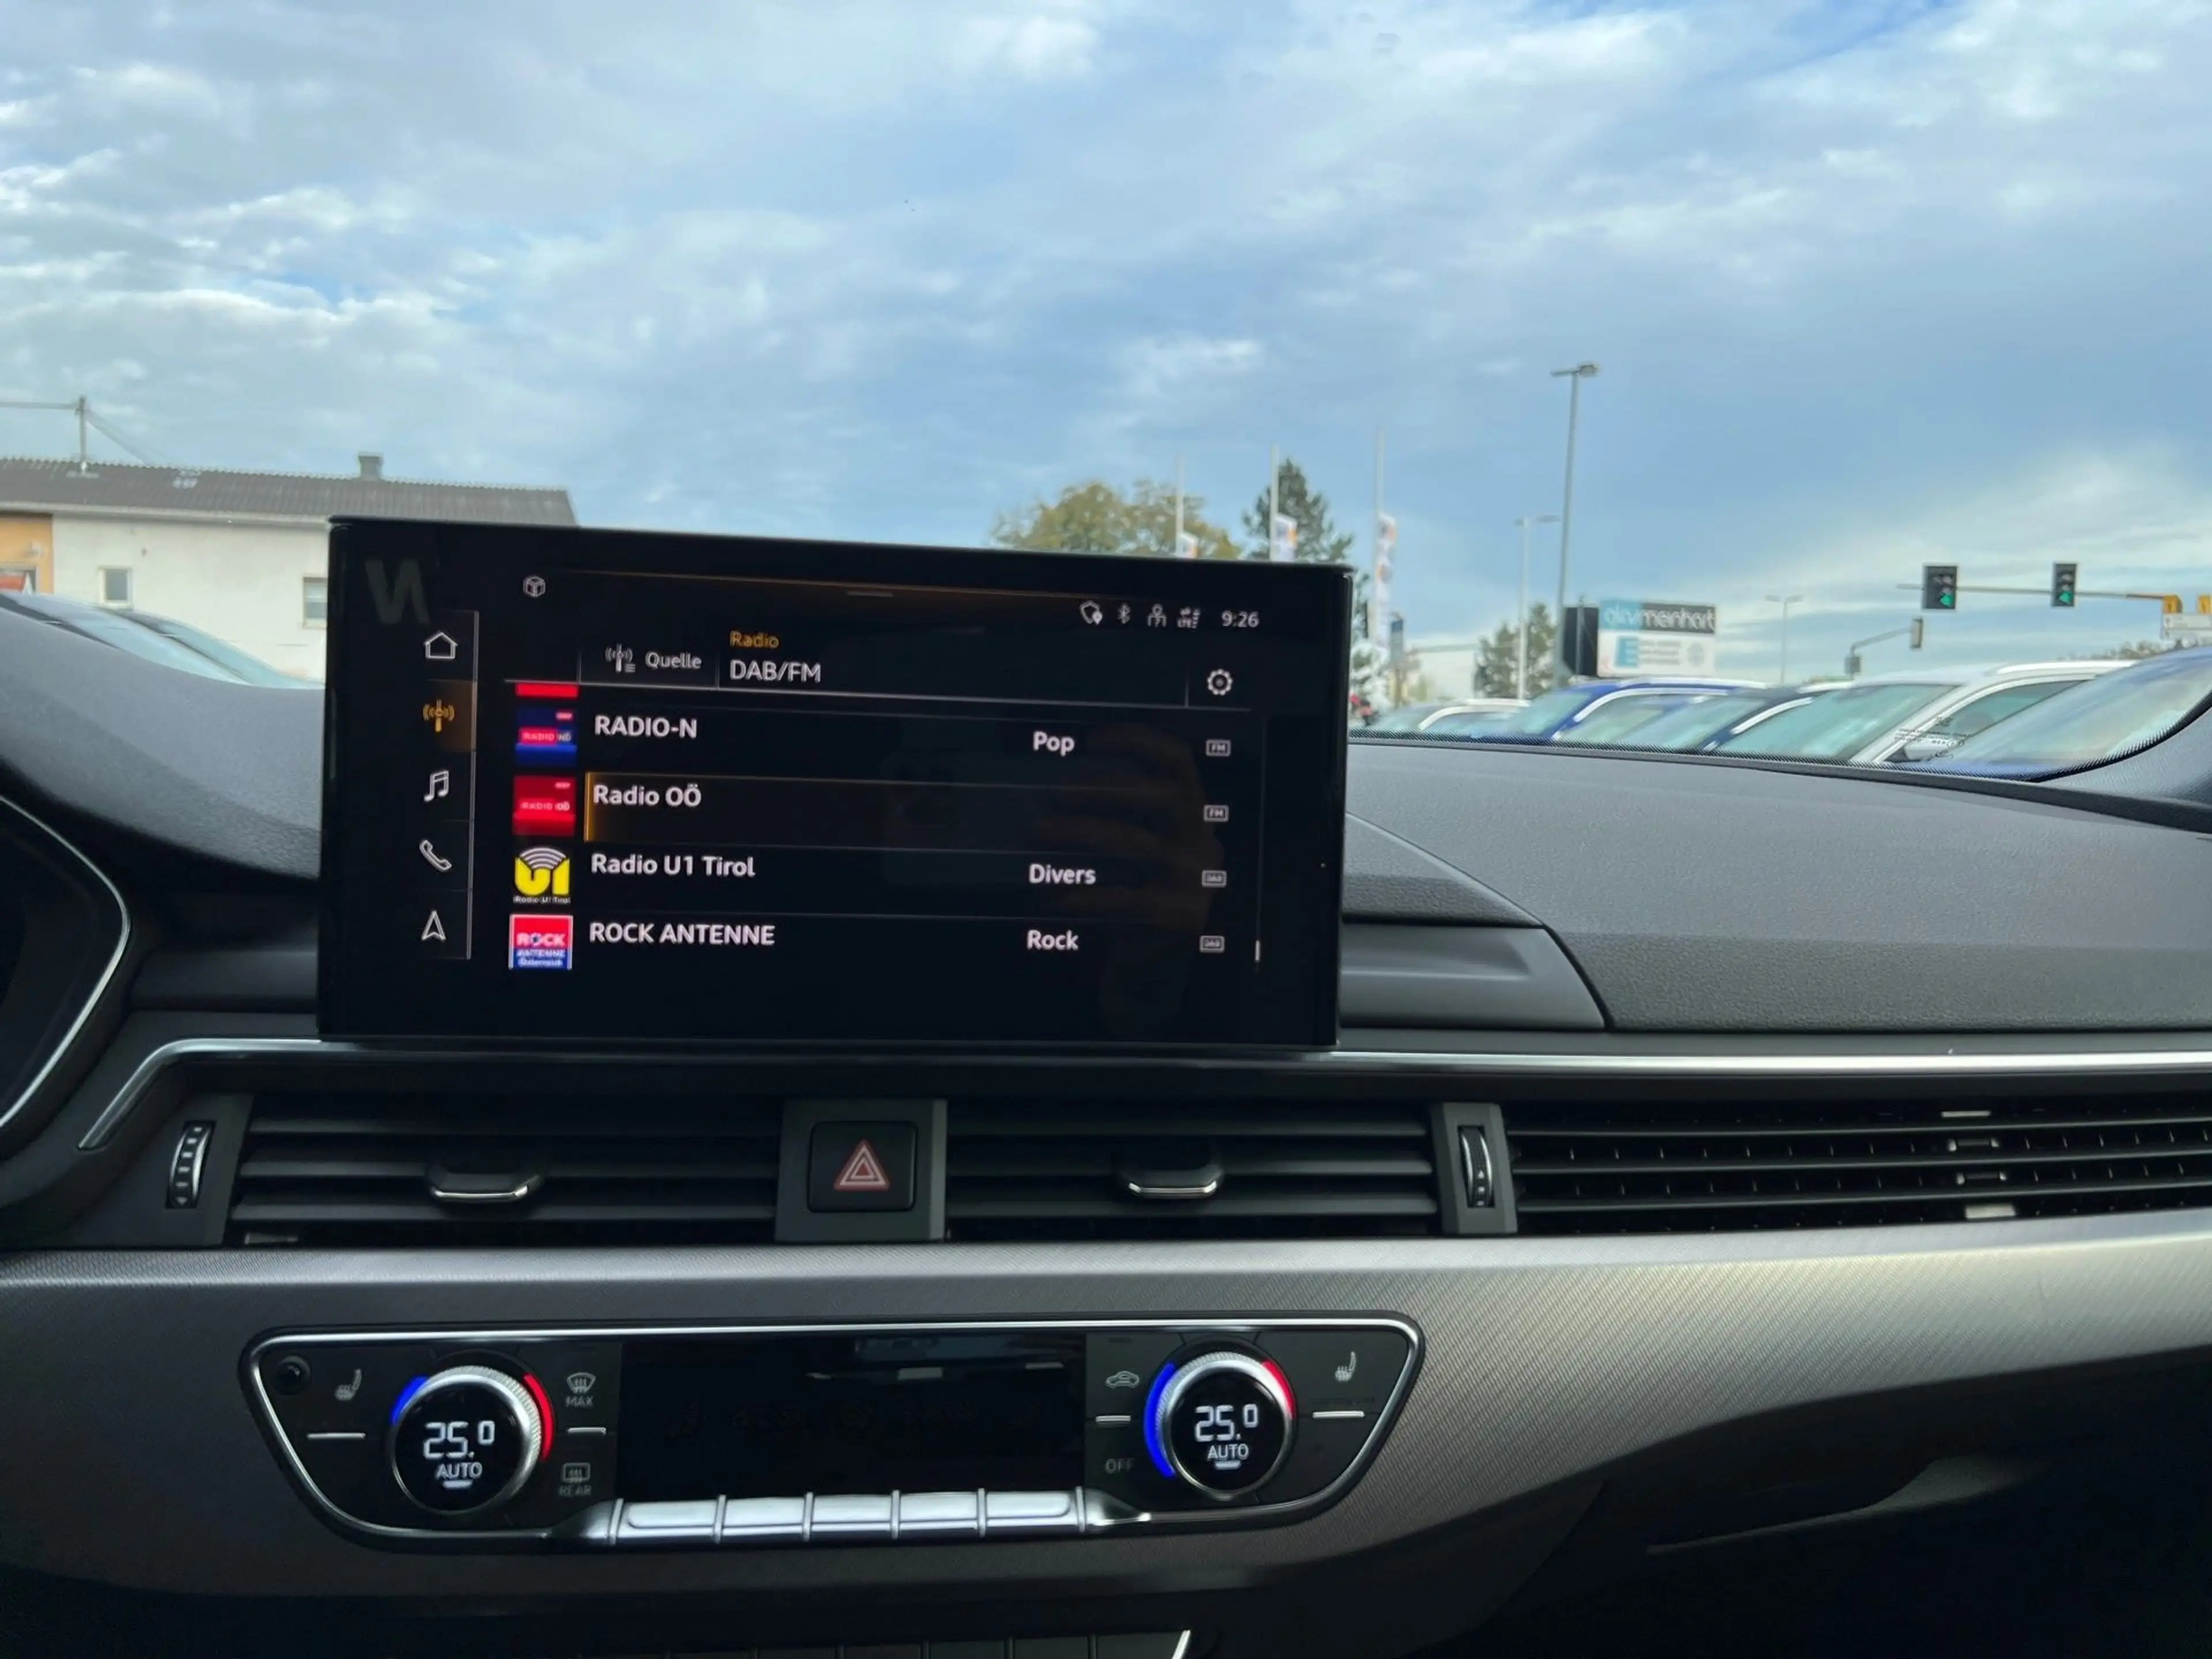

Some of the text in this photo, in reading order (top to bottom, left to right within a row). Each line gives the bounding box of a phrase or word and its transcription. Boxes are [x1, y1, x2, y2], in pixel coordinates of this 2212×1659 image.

[1221, 611, 1259, 628] 9:26
[730, 631, 779, 648] Radio
[645, 652, 702, 669] Quelle
[730, 660, 821, 683] DAB/FM
[594, 715, 697, 738] RADIO-N
[1033, 731, 1075, 756] Pop
[592, 783, 702, 807] Radio OÖ
[591, 853, 756, 877] Radio U1 Tirol
[1029, 863, 1096, 885] Divers
[516, 932, 566, 948] ROCK
[589, 922, 775, 945] ROCK ANTENNE
[1027, 929, 1078, 950] Rock
[566, 1395, 592, 1407] MAX
[1207, 1443, 1249, 1460] AUTO
[436, 1461, 483, 1479] AUTO
[1104, 1457, 1134, 1475] OFF
[559, 1484, 592, 1497] REAR
